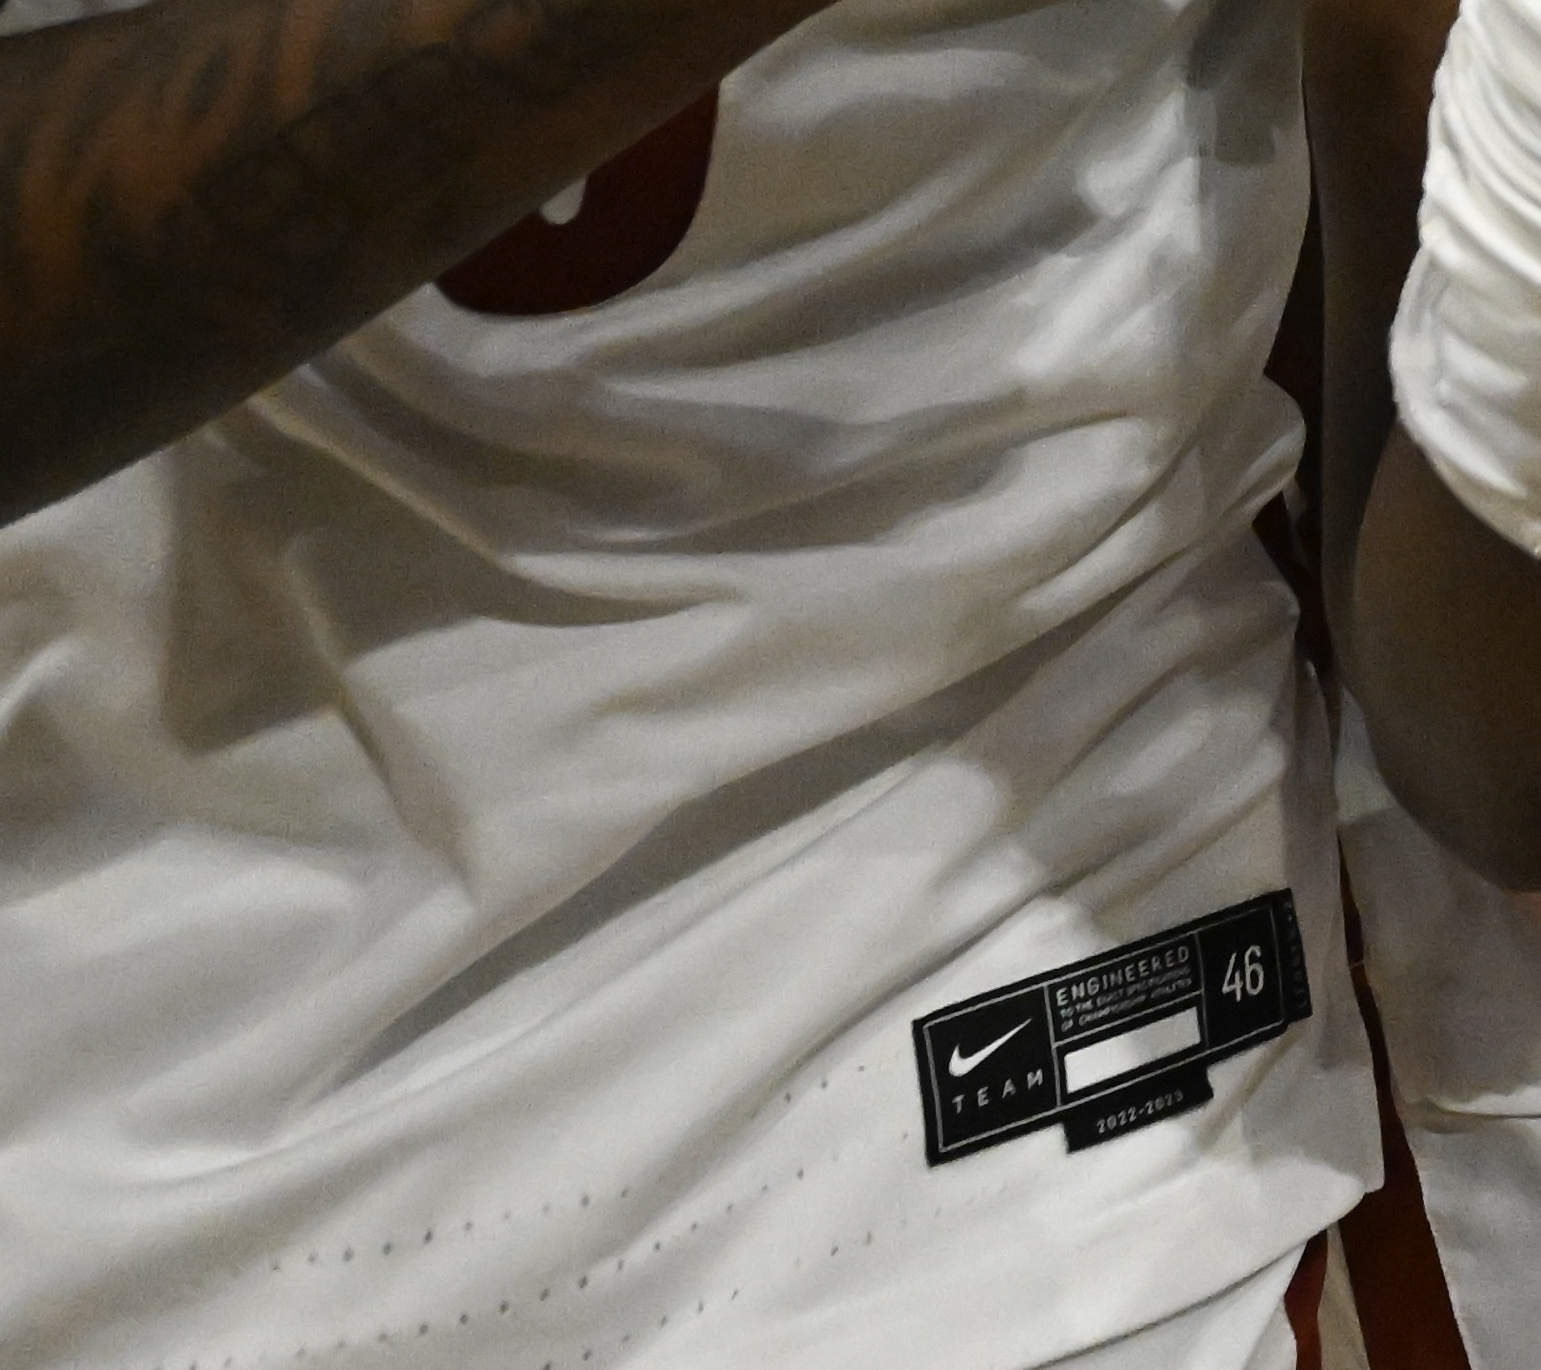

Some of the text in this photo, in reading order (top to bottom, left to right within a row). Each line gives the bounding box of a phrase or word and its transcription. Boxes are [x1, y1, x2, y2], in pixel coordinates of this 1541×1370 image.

[1056, 945, 1191, 1007] ENGINEERED
[1221, 944, 1265, 1003] 46
[951, 1068, 1045, 1115] TEAM
